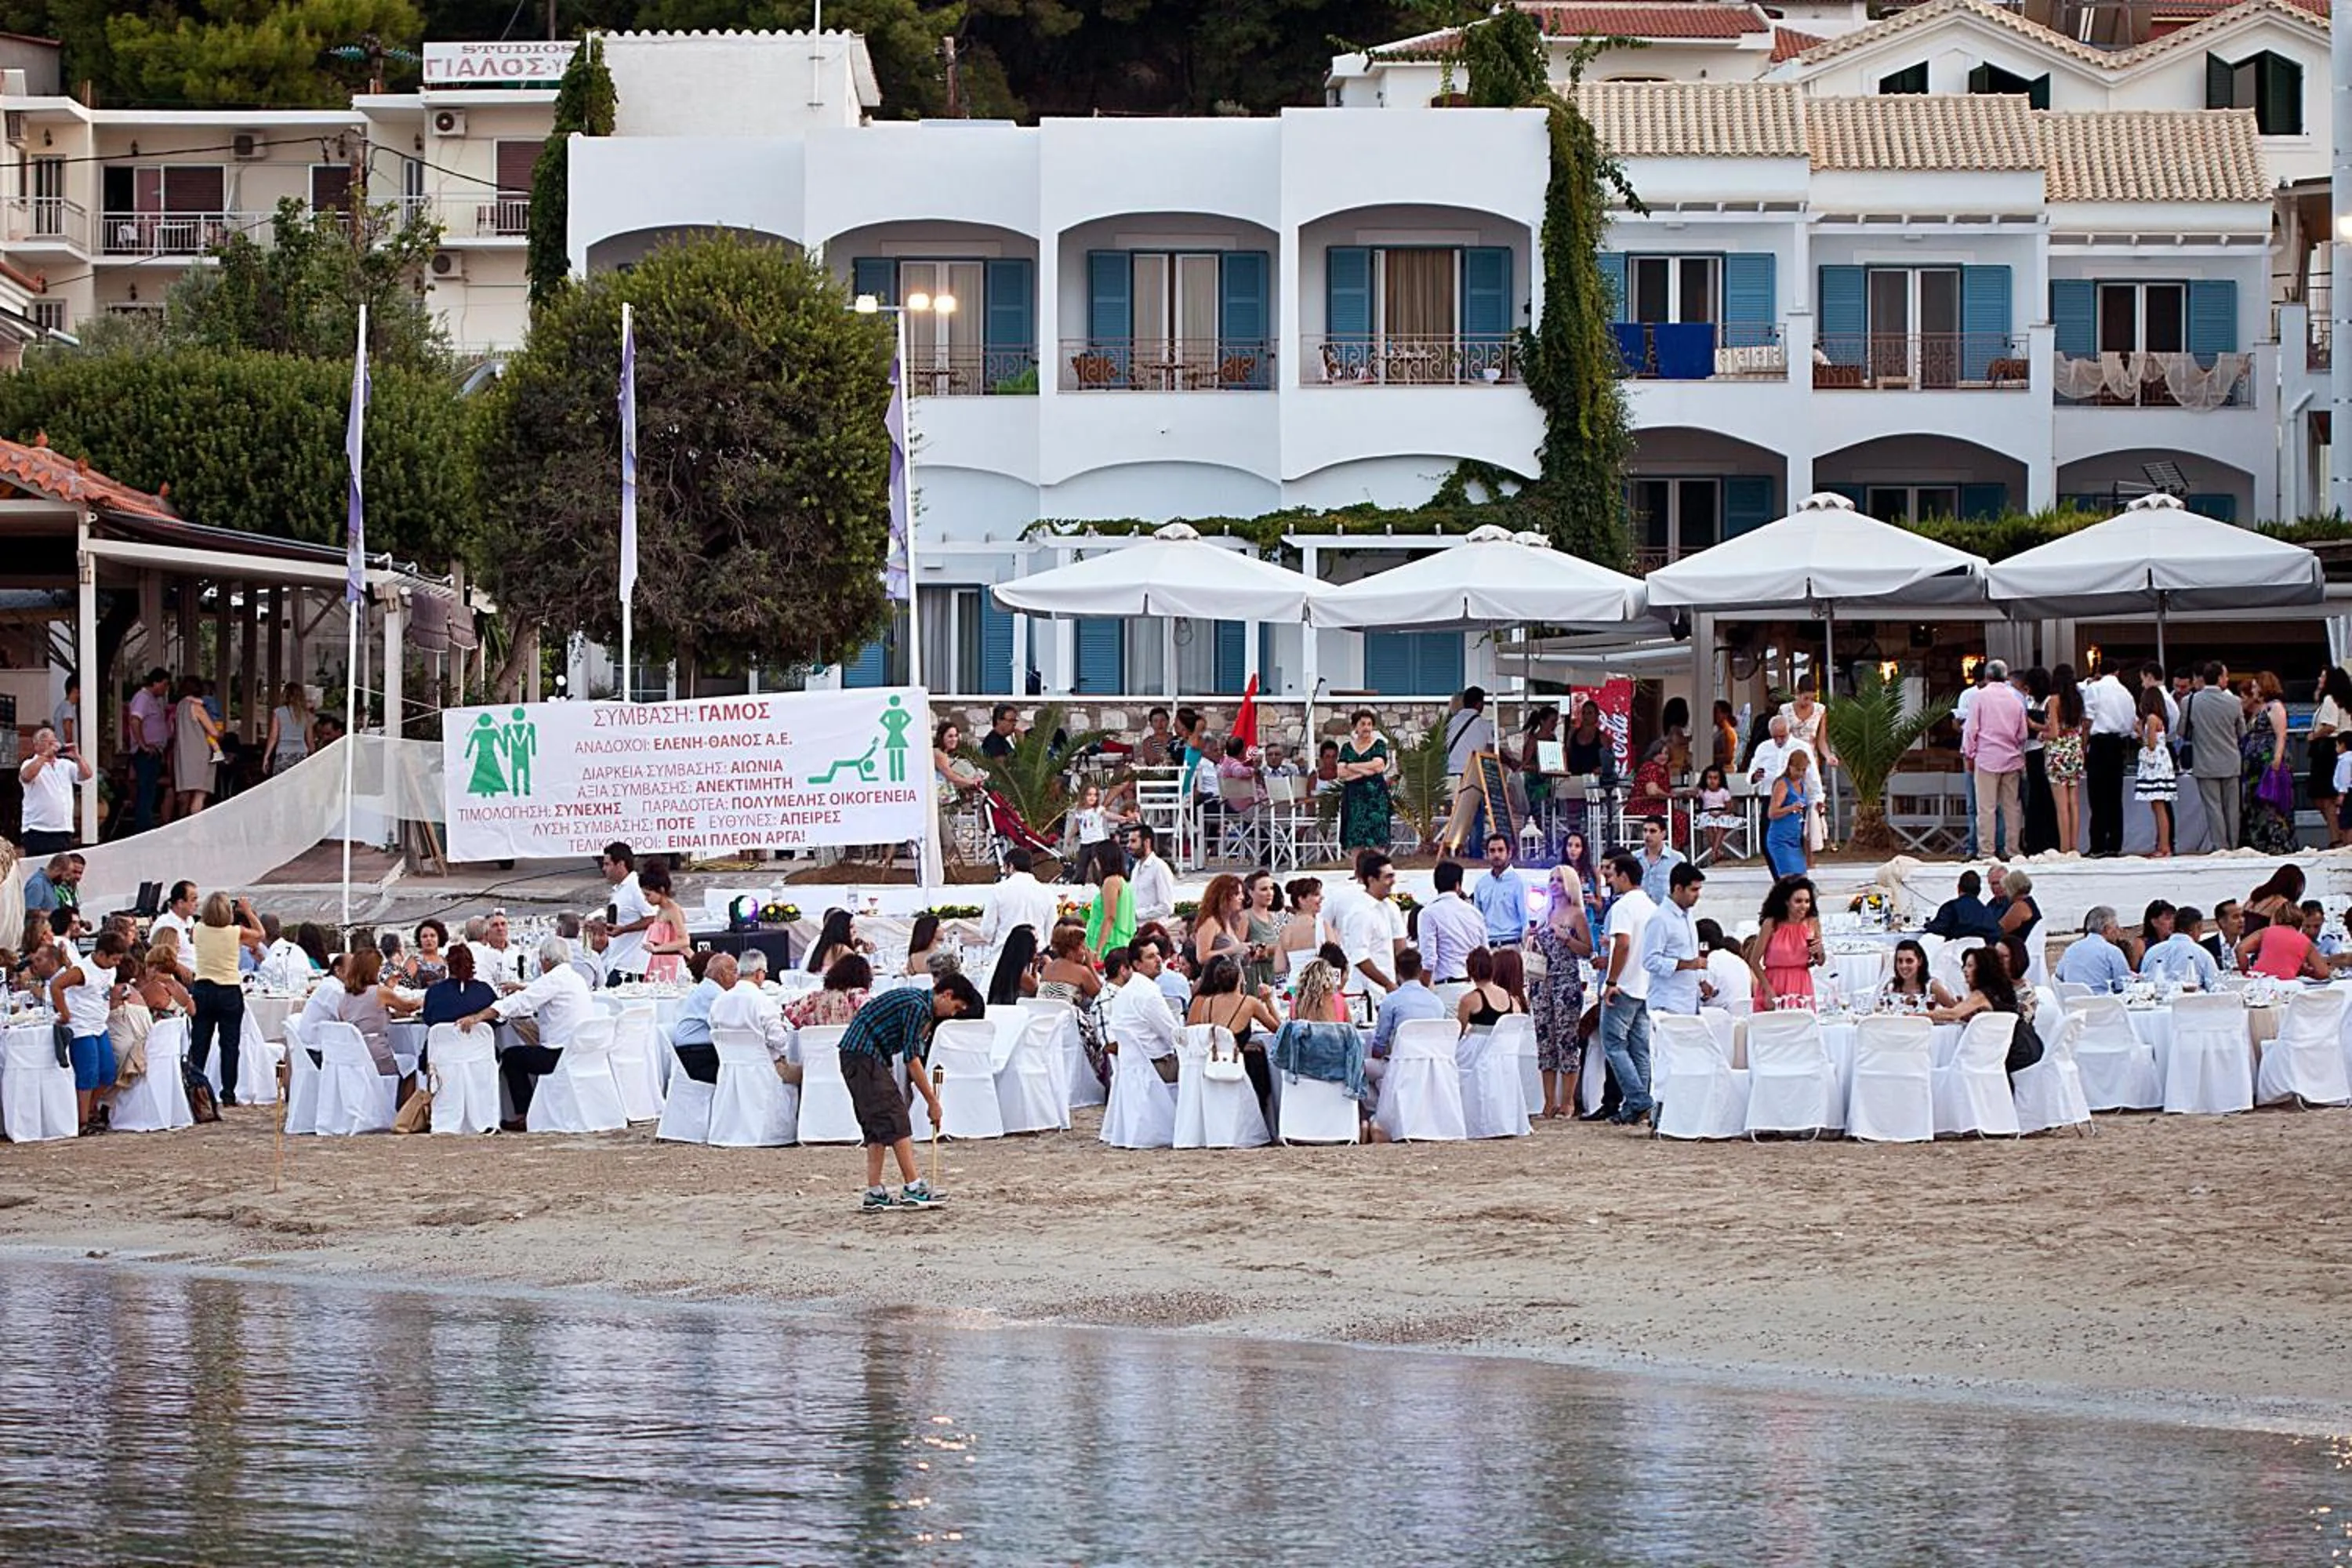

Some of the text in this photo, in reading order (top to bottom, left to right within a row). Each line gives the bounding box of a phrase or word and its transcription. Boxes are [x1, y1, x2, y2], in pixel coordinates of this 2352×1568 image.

[462, 44, 576, 54] STUDIOS
[593, 702, 770, 727] ΣΥΜΒΑΣΗ: ΓΑΜΟΣ
[575, 732, 793, 753] ΑΝΑΔΟΧΟΙ: ΕΛΕΝΗ-ΘΑΝΟΣ Α.Ε.
[646, 761, 728, 778] ΣΥΜΒΑΣΗΣ:
[731, 759, 783, 774] ΑΙΩΝΙΑ
[577, 777, 793, 799] ΑΞΙΑ ΣΥΜΒΑΣΗΣ: ΑΝΕΚΤΙΜΗΤΗ
[457, 789, 917, 822] ΤΙΜΟΛΟΓΗΣΗ: ΣΥΝΕΧΗΣ ΠΑΡΑΔΟΤΕΑ: ΠΟΛΥΜΕΛΗΣ ΟΙΚΟΓΕΝΕΙΑ
[532, 810, 841, 837] ΛΥΣΗ ΣΥΜΒΑΣΗΣ: ΠΟΤΕ ΕΥΘΥΝΕΣ: ΑΠΕΙΡΕΣ
[667, 834, 706, 848] ΕΙΝΑΙ
[710, 832, 762, 847] ΠΛΕΟΝ
[765, 830, 805, 844] ΑΡΓΑ!
